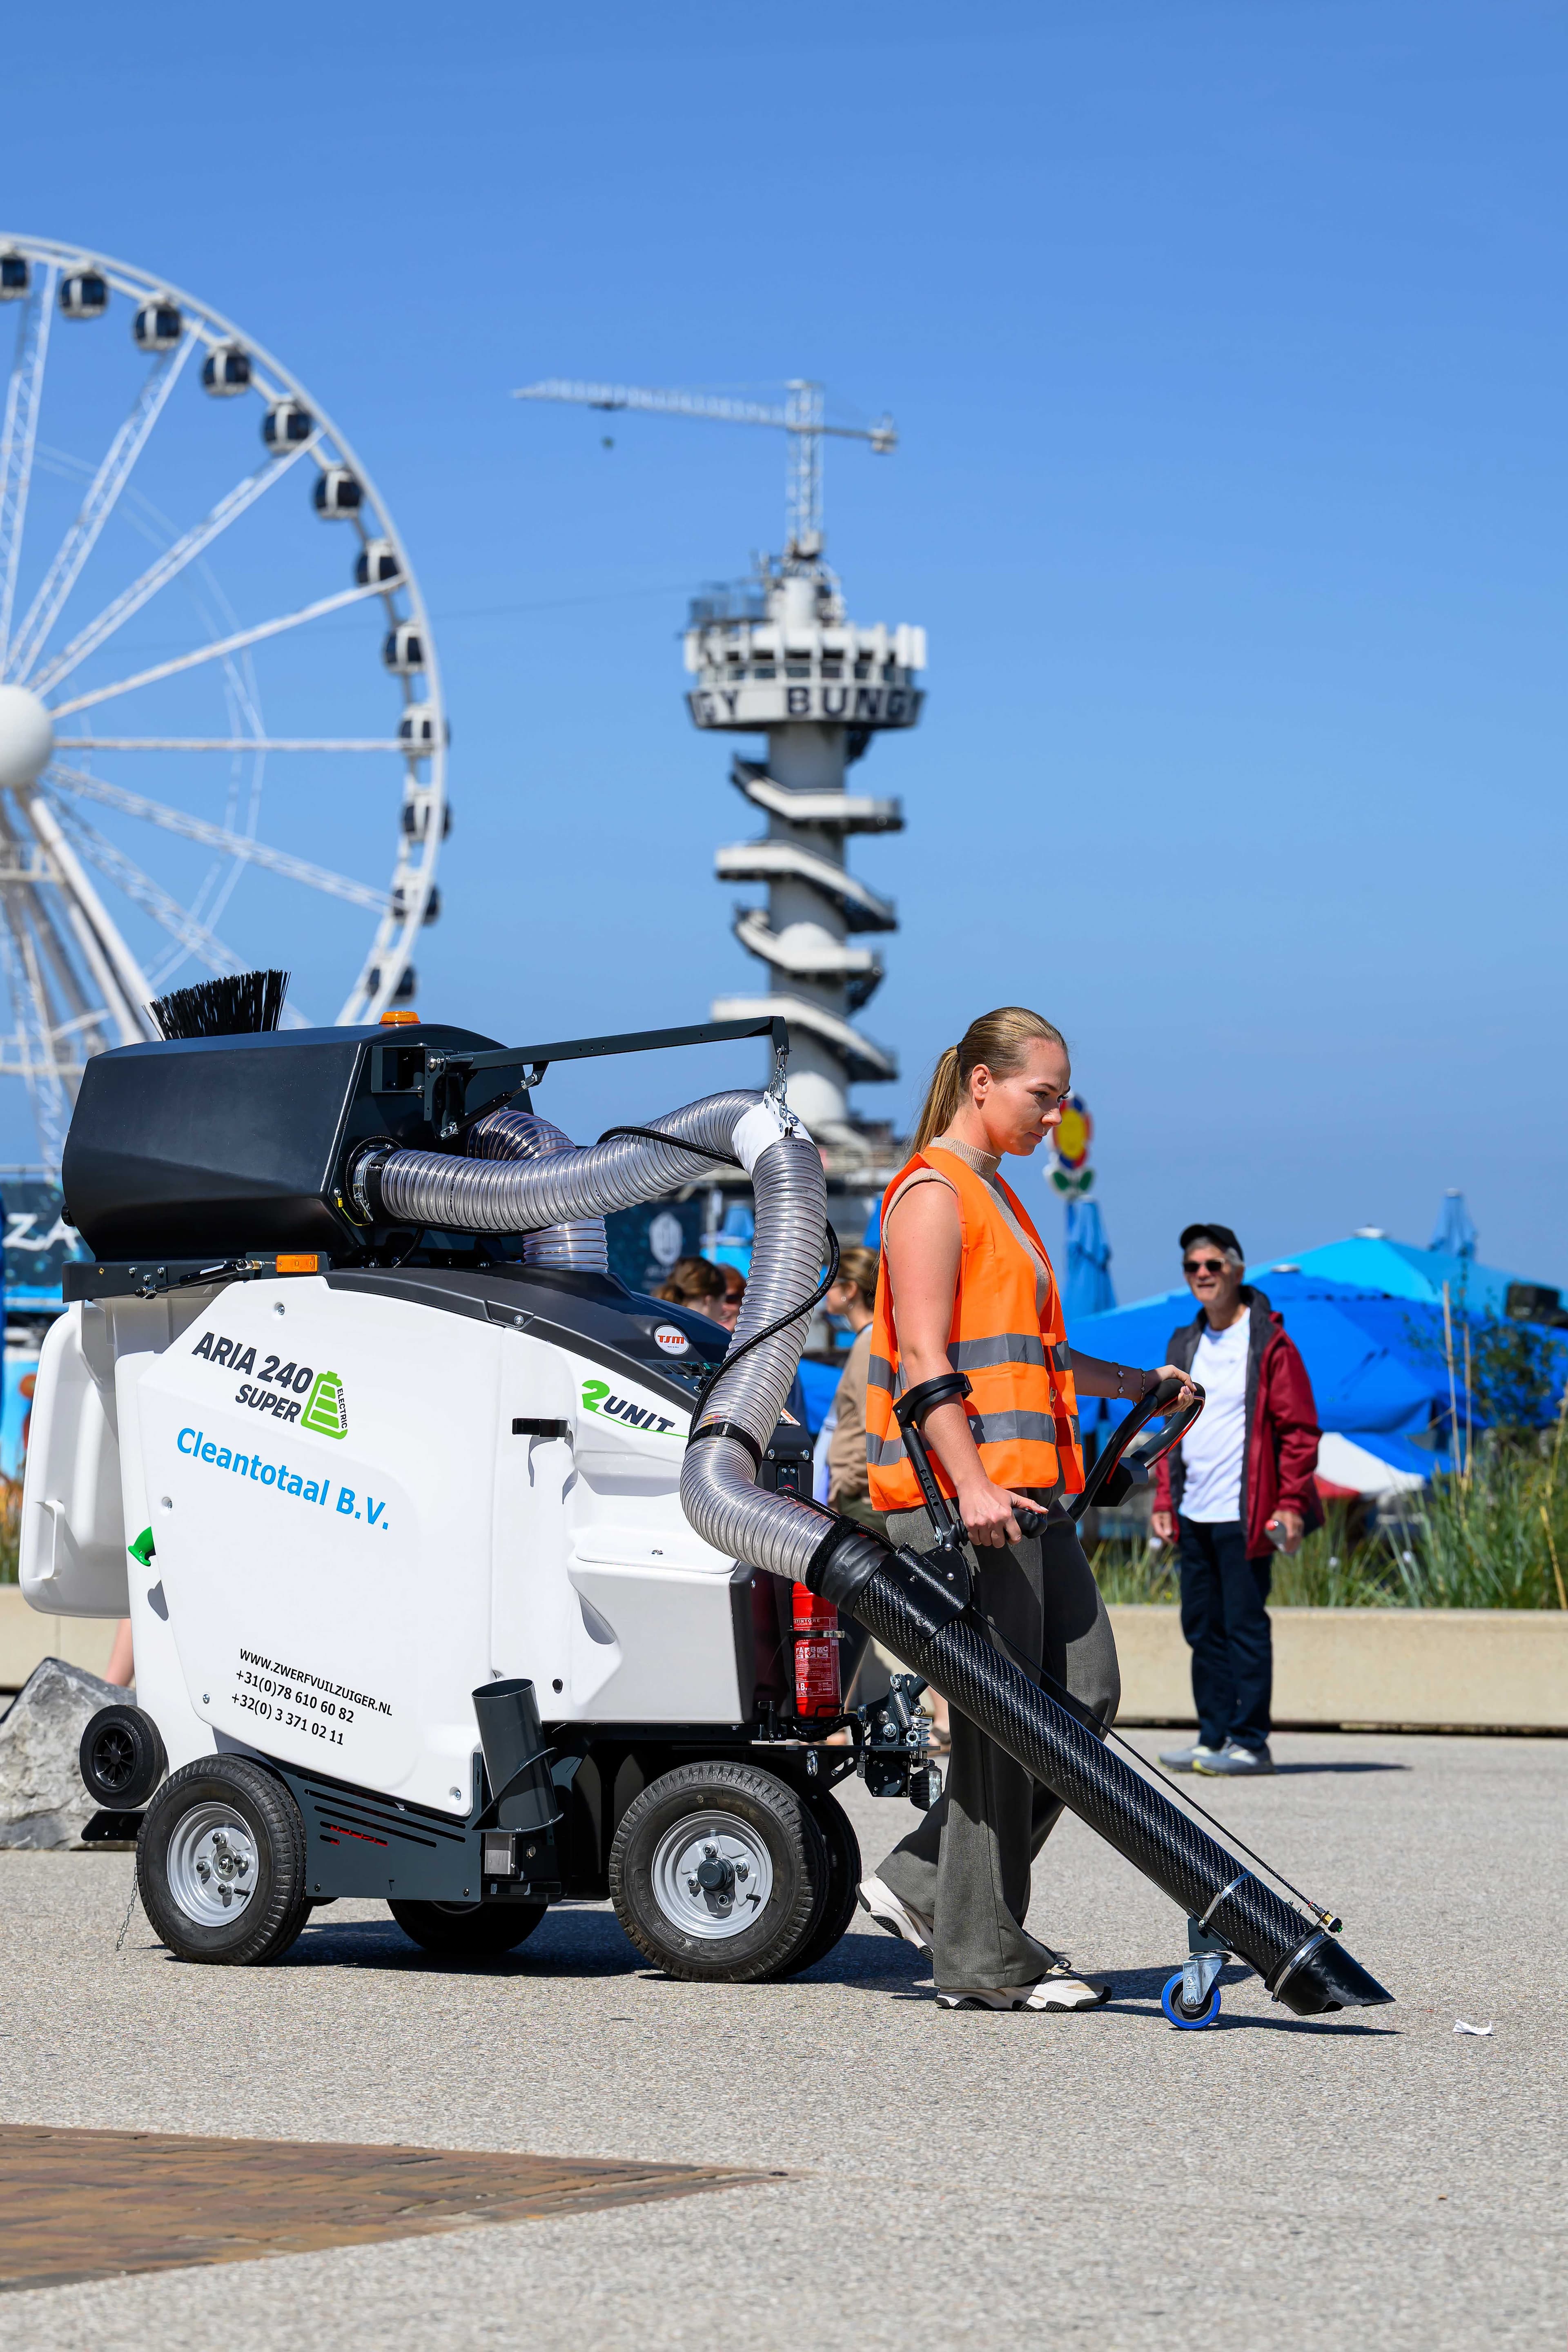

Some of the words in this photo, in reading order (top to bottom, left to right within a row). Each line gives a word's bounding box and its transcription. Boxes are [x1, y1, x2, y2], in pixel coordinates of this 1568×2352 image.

[192, 1332, 257, 1375] ARIA
[257, 1355, 313, 1393] 240
[657, 1335, 684, 1344] TSM
[235, 1384, 301, 1423] SUPER
[337, 1388, 347, 1429] ELECTRIC
[177, 1428, 330, 1506] Cleantotaal
[336, 1487, 388, 1530] B.V.
[236, 1670, 292, 1700] +31(0)78
[295, 1692, 317, 1709] 610
[321, 1701, 335, 1716] 60
[339, 1707, 354, 1723] 82
[240, 1648, 393, 1716] WWW.ZWERFVUILZUIGER.NL
[232, 1693, 272, 1719] +32(0)
[275, 1708, 283, 1721] 3
[286, 1712, 307, 1731] 371
[312, 1723, 327, 1739] 02
[330, 1730, 343, 1745] 11
